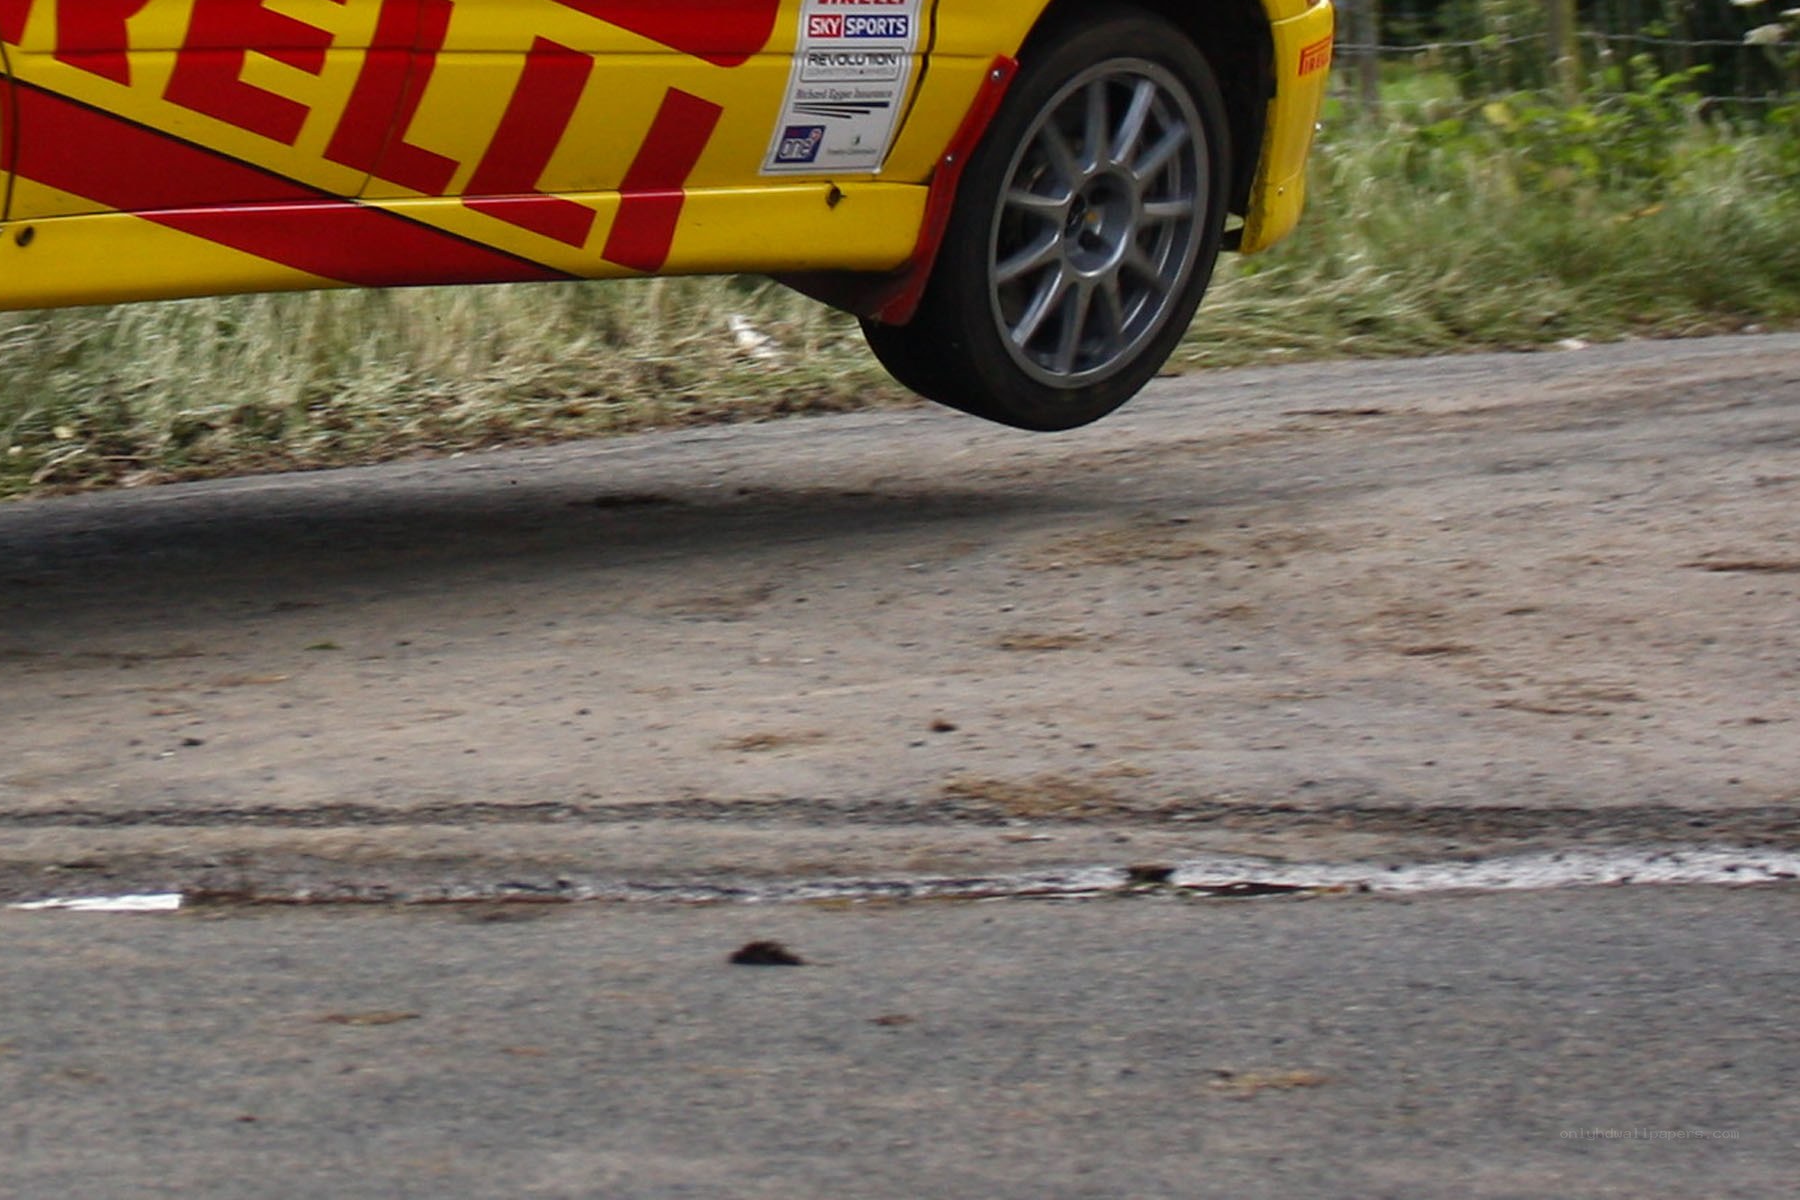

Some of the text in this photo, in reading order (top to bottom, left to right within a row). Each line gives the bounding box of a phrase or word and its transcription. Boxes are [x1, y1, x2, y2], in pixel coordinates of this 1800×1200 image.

[809, 17, 907, 36] SKY SPORTS
[807, 53, 898, 67] REVOLUTION
